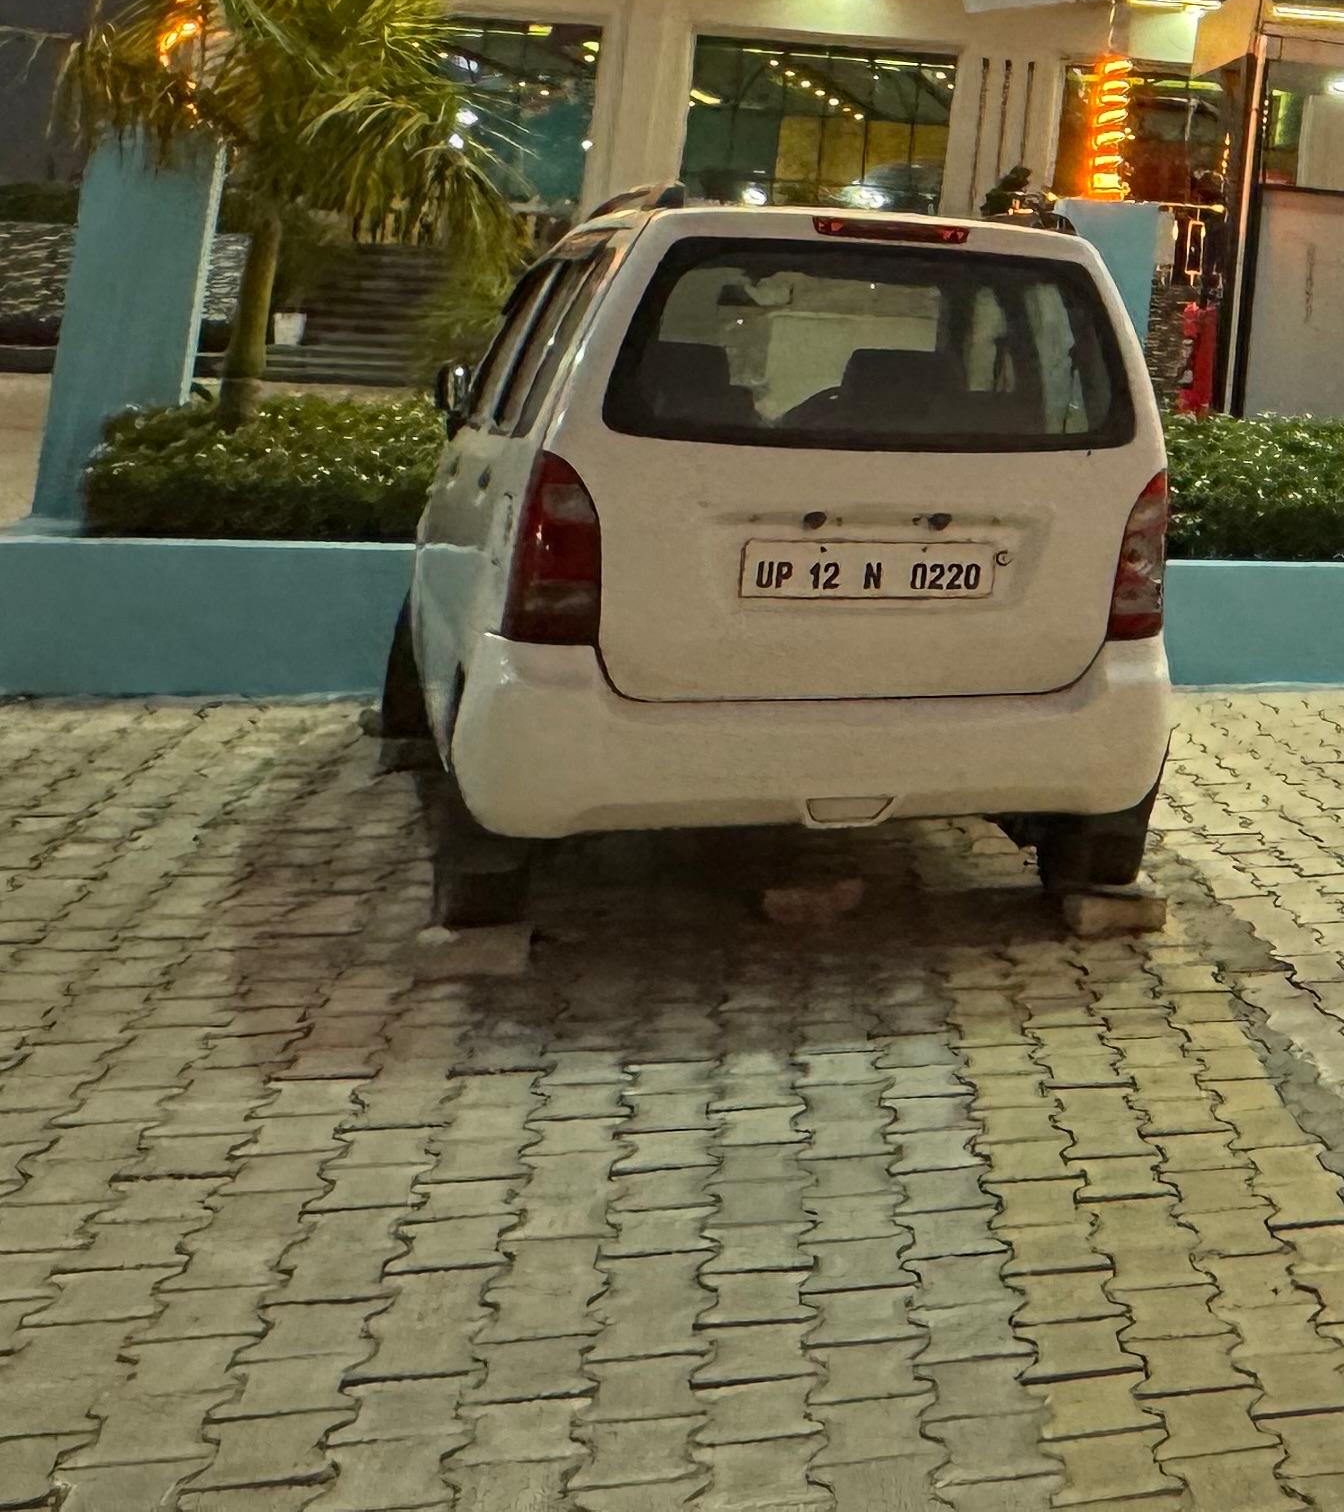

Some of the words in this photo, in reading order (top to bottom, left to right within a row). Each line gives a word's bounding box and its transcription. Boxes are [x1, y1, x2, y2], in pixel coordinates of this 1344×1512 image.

[756, 561, 793, 589] UP
[809, 562, 840, 590] 12
[863, 561, 883, 590] N
[910, 562, 982, 590] 0220
